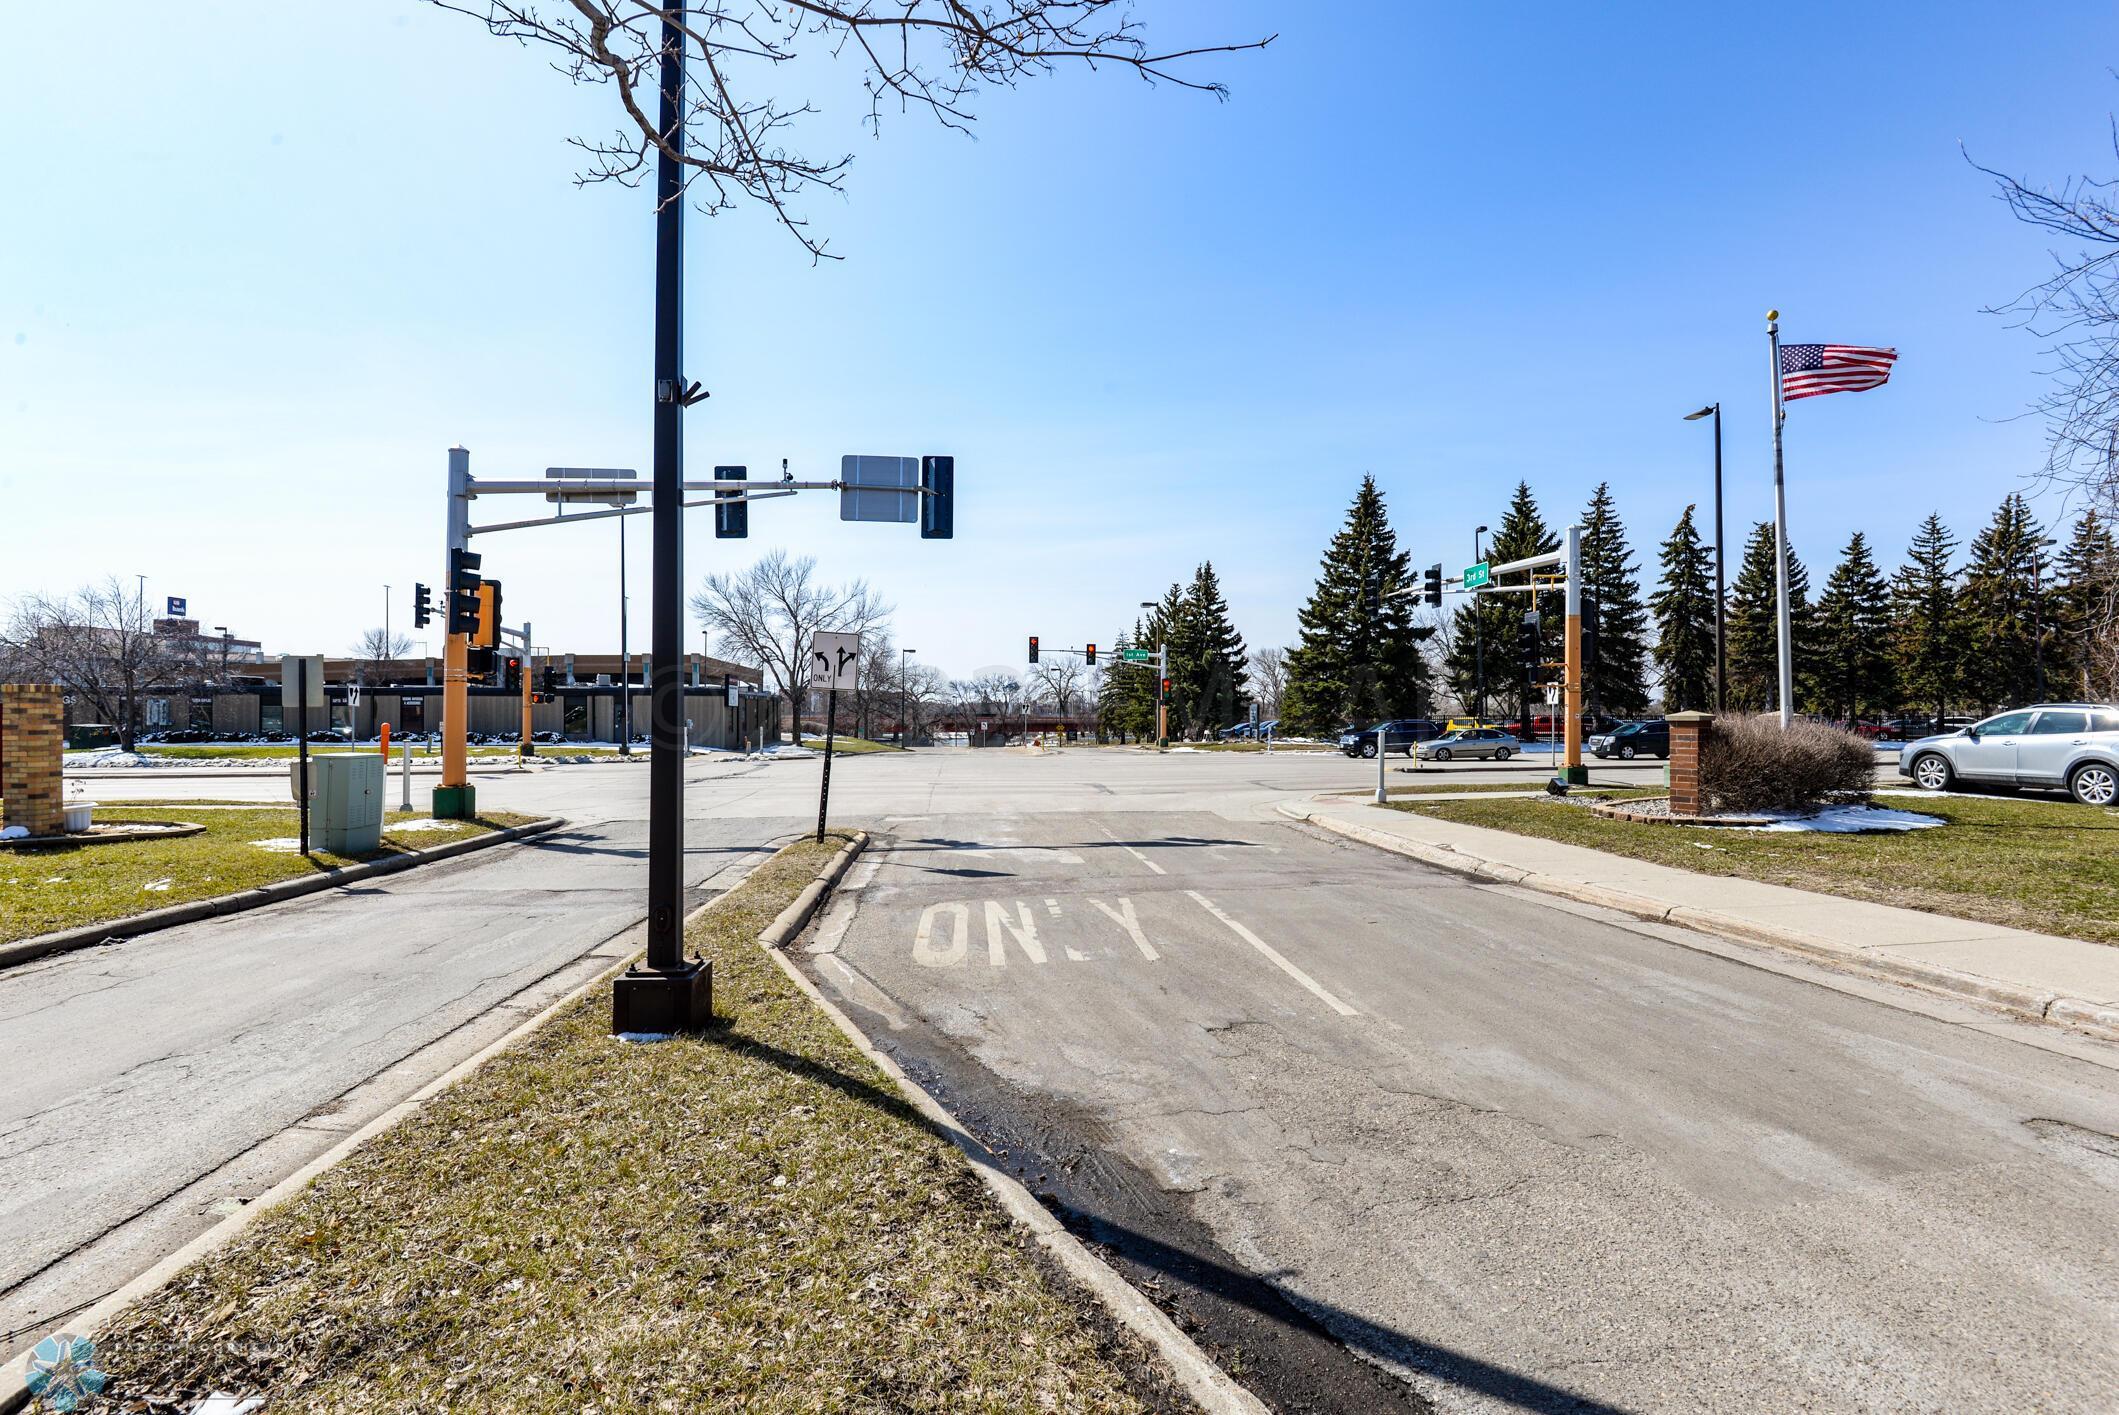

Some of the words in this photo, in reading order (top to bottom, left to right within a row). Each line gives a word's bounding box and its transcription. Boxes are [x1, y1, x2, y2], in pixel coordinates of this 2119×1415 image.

[1467, 571, 1477, 583] 3rd
[1479, 569, 1485, 579] St
[813, 673, 832, 682] ONLY
